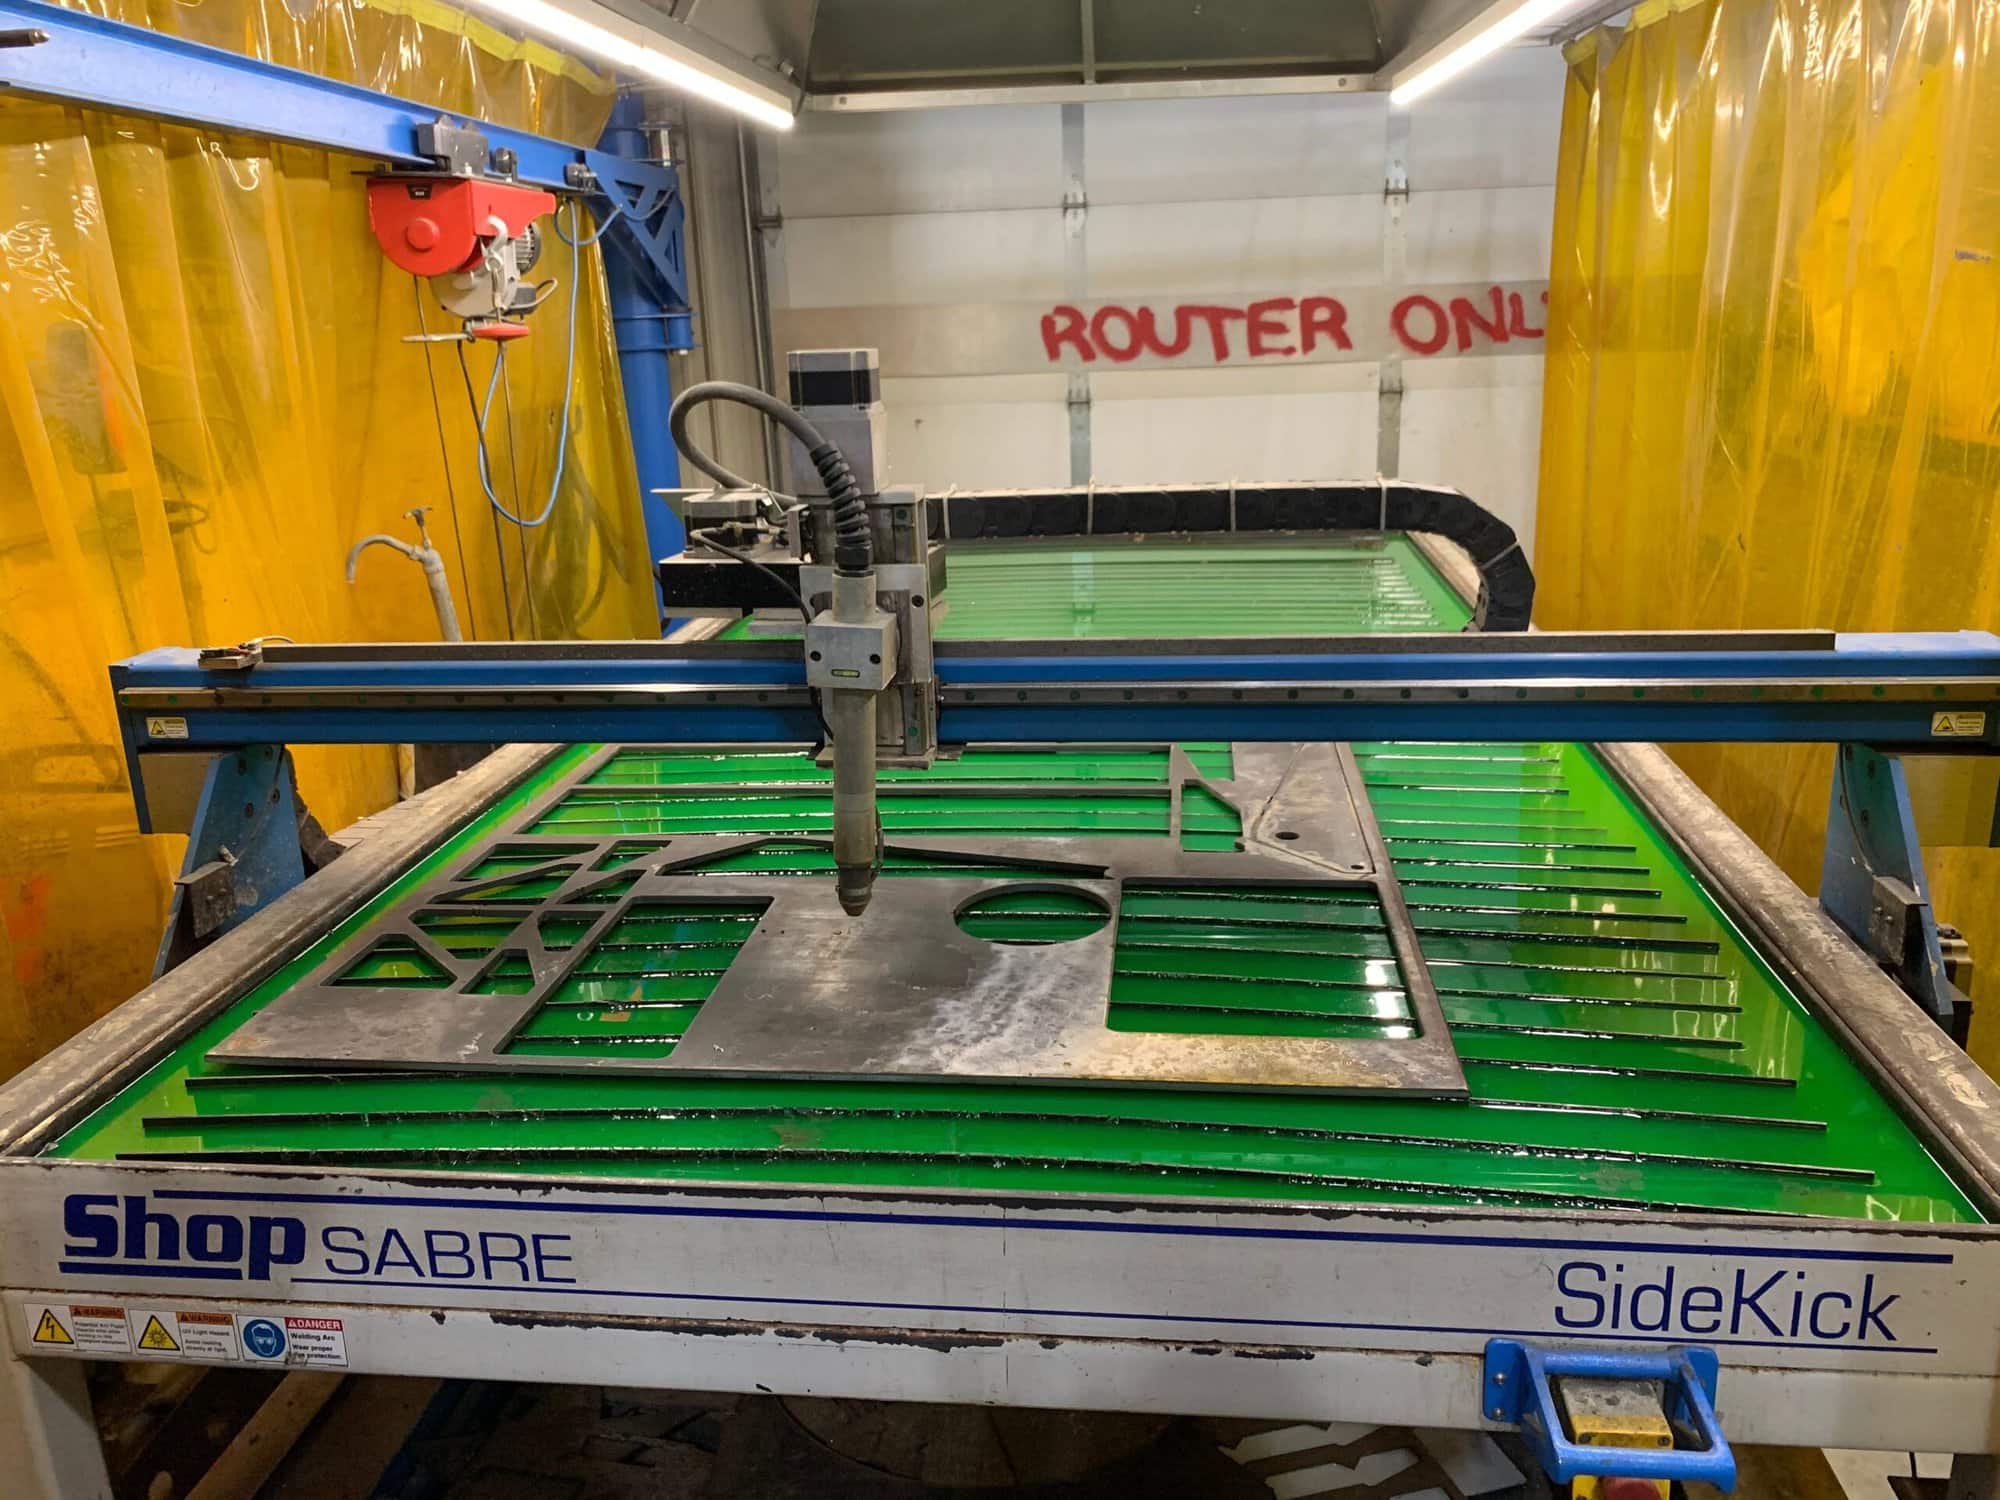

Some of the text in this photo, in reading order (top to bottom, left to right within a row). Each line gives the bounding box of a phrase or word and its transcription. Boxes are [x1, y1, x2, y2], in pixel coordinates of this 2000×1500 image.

[1040, 286, 1549, 363] ROUTER ONL
[64, 1194, 577, 1284] Shop SABRE
[290, 1332, 321, 1341] Welding
[296, 1319, 341, 1330] DANGER
[1554, 1261, 1900, 1341] SideKick
